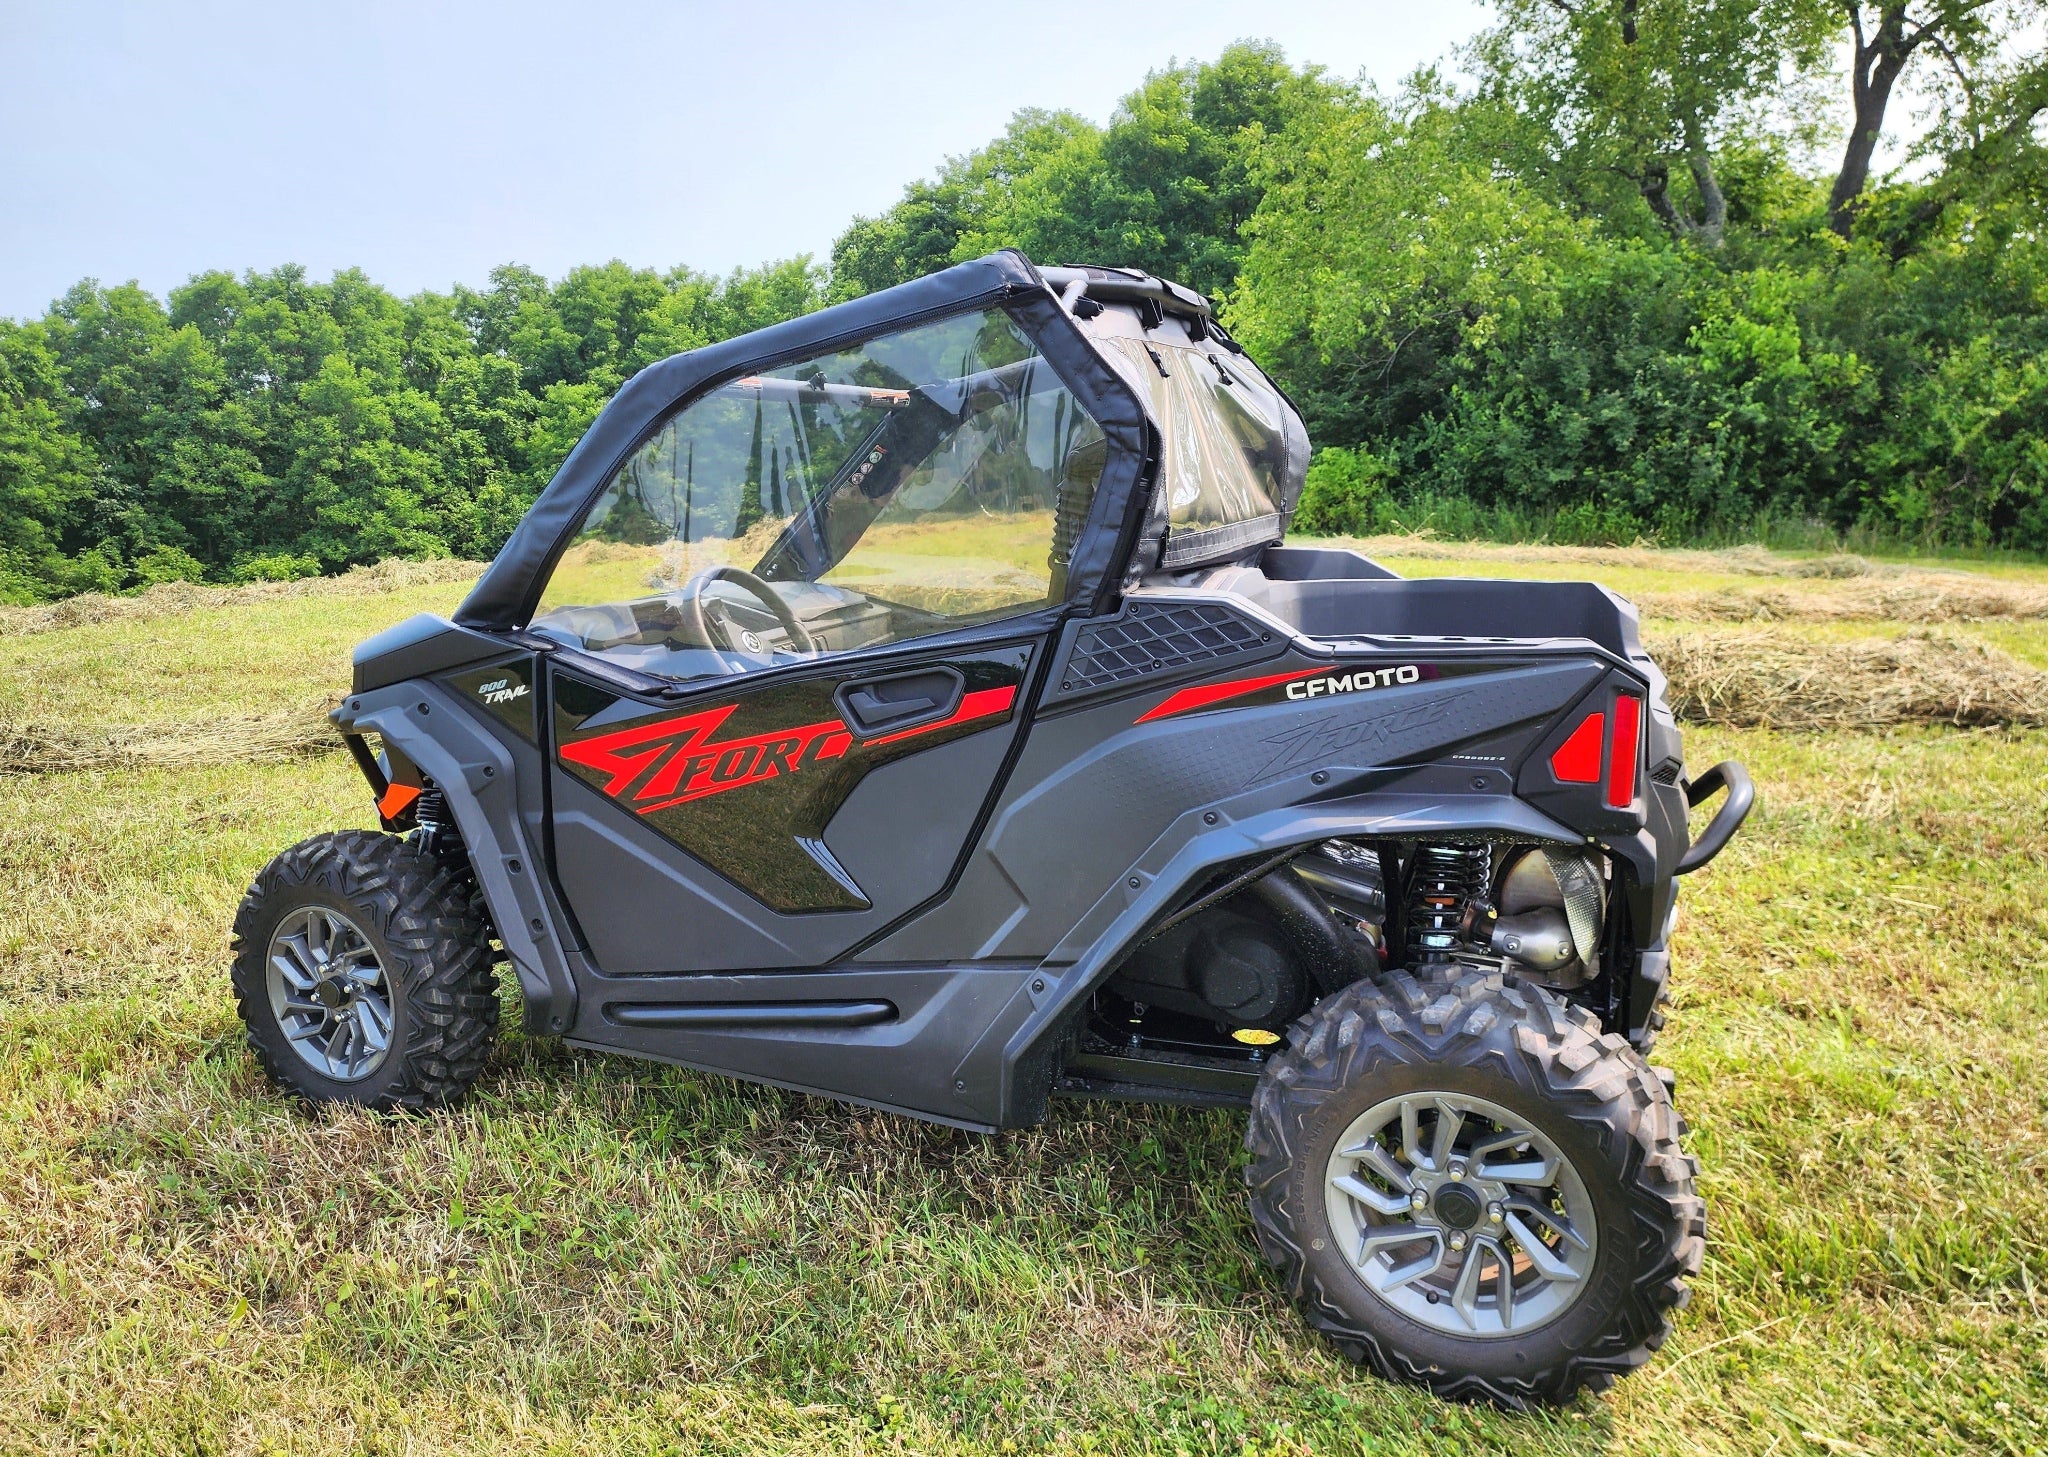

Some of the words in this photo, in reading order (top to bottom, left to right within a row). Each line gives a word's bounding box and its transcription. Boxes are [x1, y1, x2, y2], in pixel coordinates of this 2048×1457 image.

[478, 679, 508, 694] 800
[1285, 665, 1420, 700] CFMOTO
[484, 684, 531, 704] TRAIL
